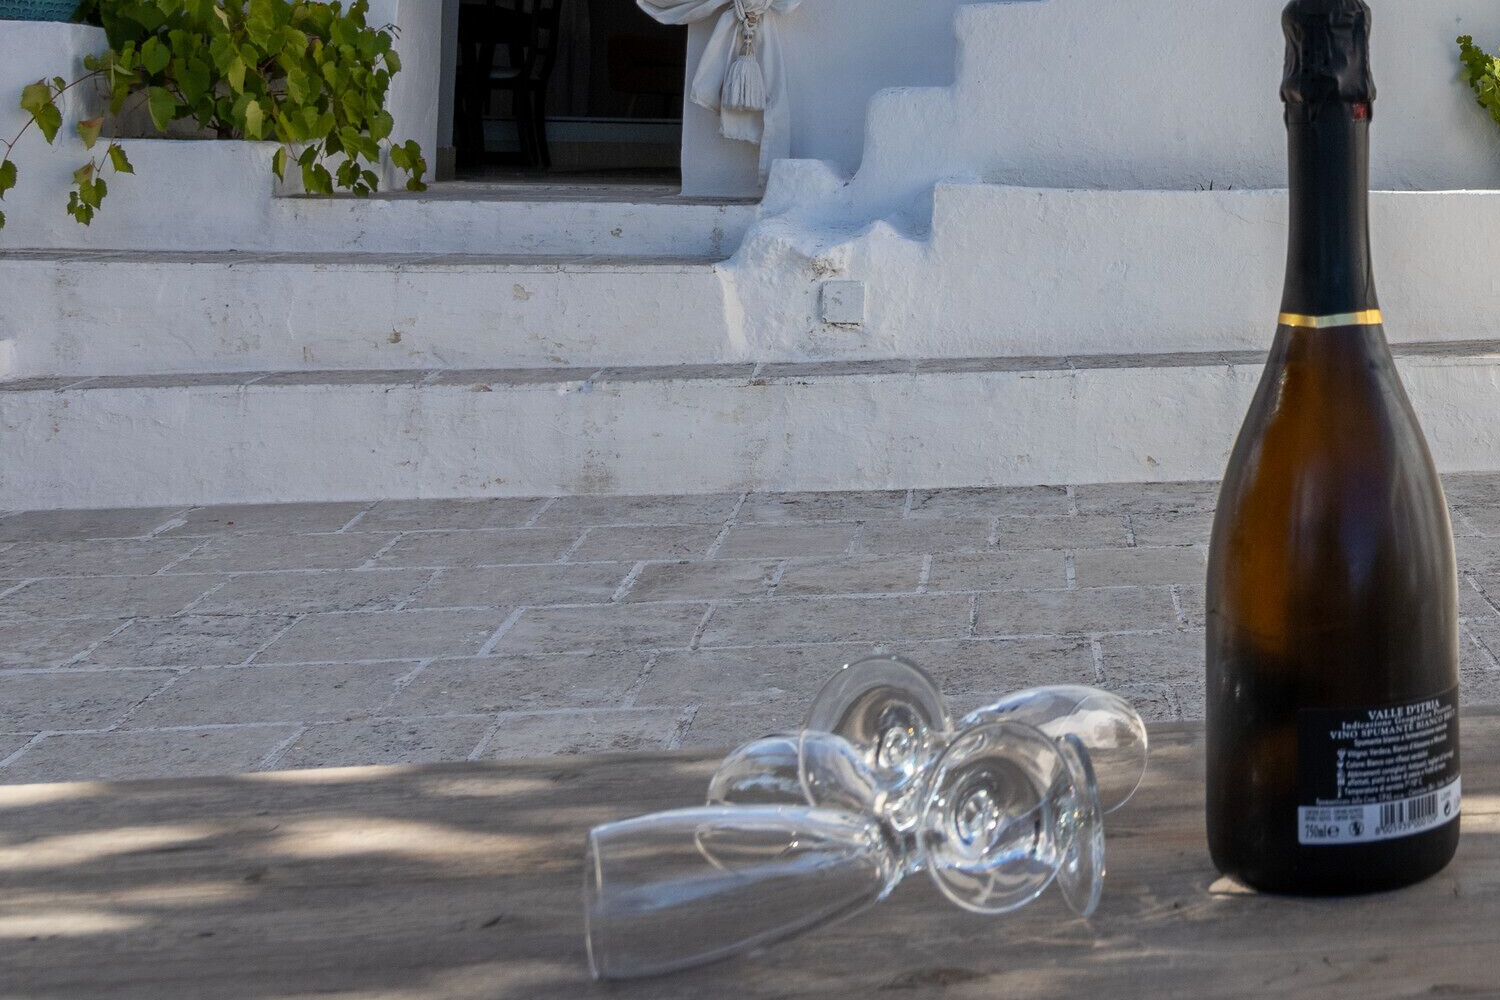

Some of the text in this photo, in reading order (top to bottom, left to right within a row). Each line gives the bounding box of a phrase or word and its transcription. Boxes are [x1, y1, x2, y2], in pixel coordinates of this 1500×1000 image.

[1368, 699, 1440, 720] VALLE D'ITRIA
[1330, 730, 1358, 740] VINO
[1361, 724, 1413, 738] SPUMANTE
[1416, 716, 1443, 730] BIANCO
[1342, 719, 1391, 730] Indicazione
